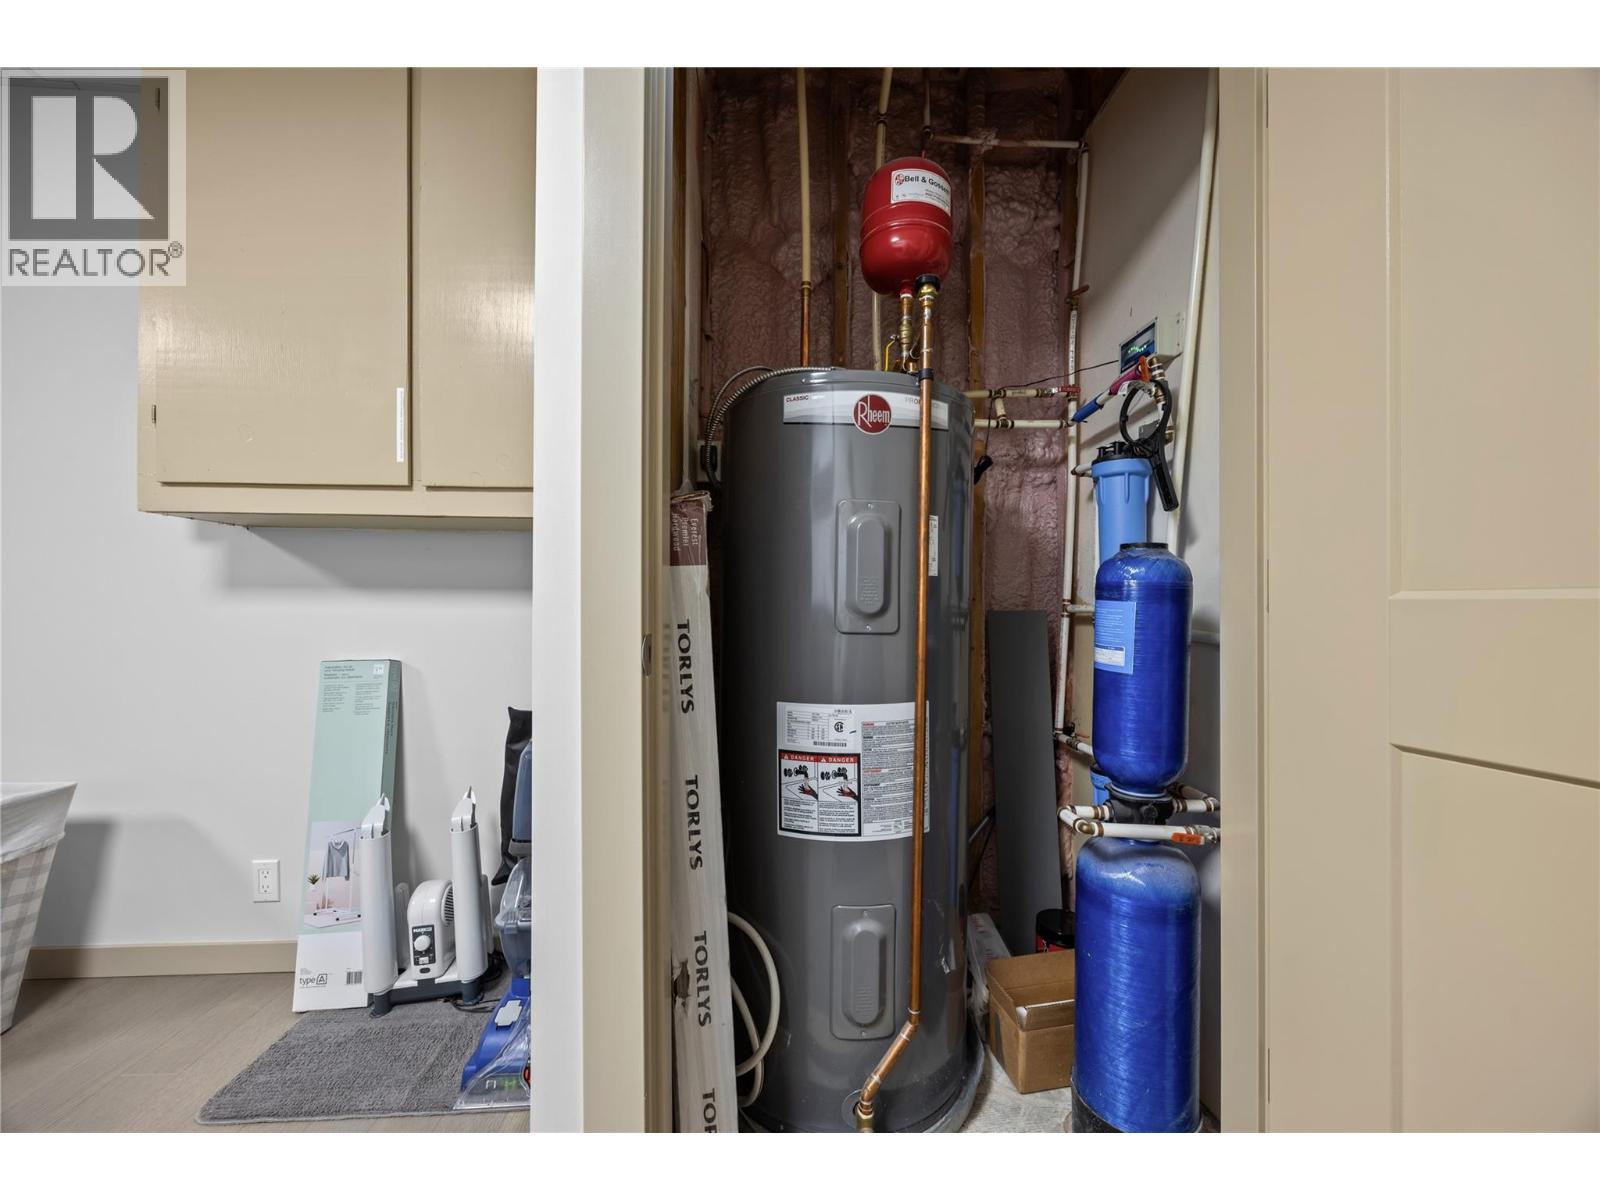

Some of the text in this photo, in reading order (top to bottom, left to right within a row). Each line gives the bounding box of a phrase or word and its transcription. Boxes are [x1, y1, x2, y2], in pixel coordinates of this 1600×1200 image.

[857, 394, 890, 428] Rheem
[671, 512, 680, 552] Hardwood
[681, 517, 689, 547] Premier
[690, 518, 699, 546] Everest
[677, 619, 695, 715] TORLYS
[685, 774, 703, 871] TORLYS
[299, 977, 316, 986] type
[694, 930, 712, 1028] TORLYS
